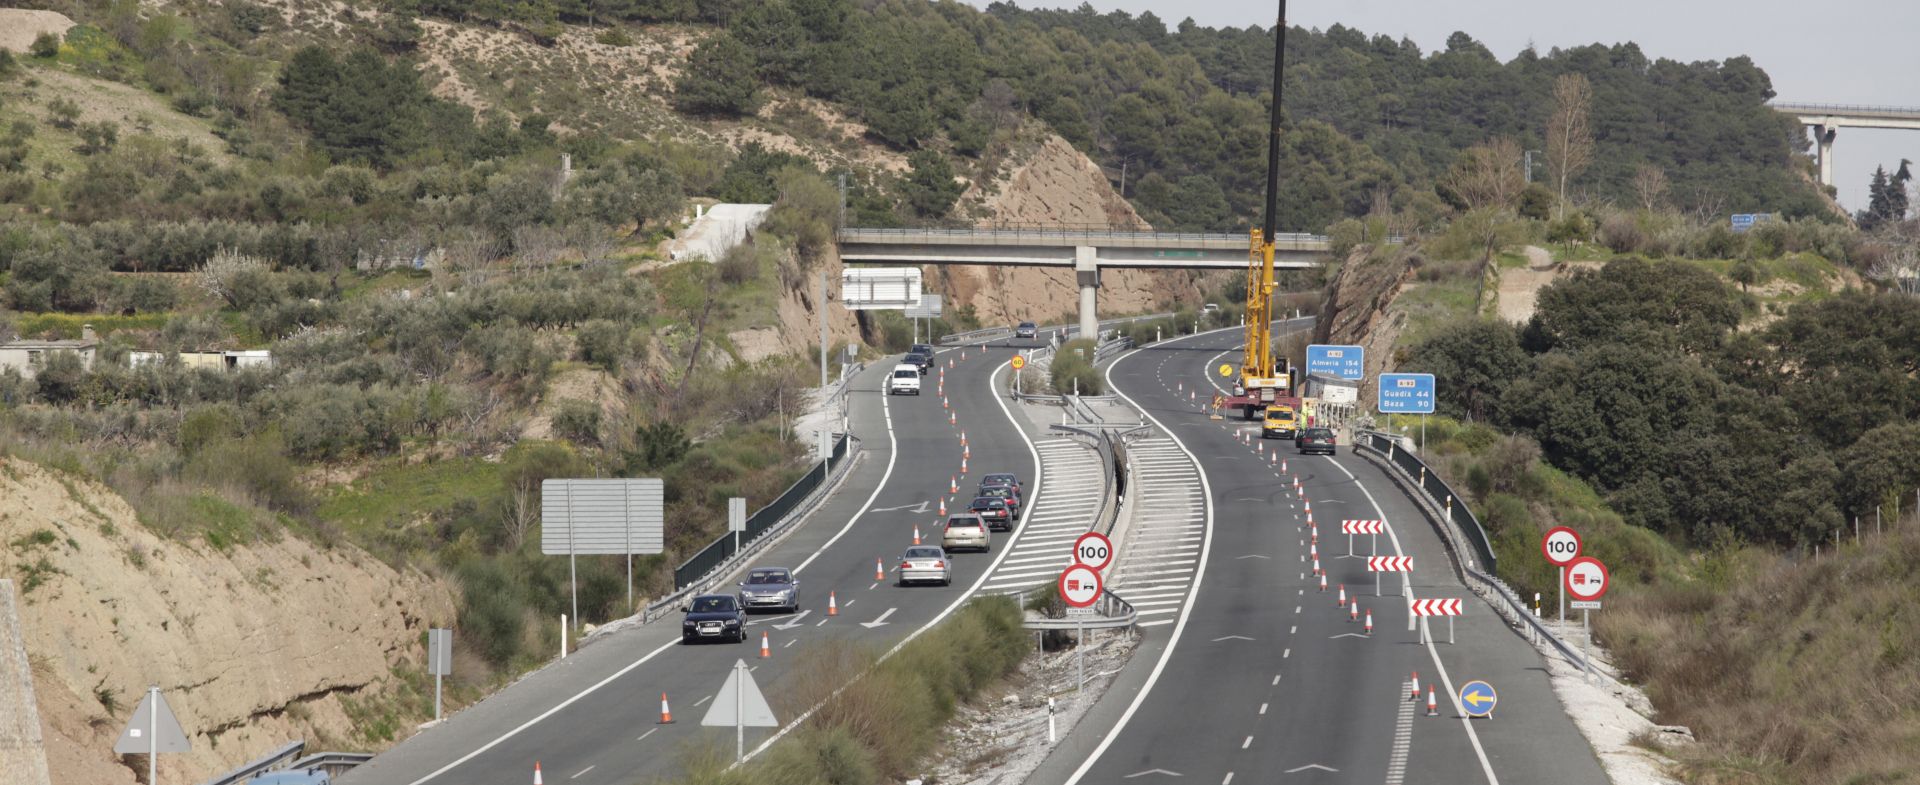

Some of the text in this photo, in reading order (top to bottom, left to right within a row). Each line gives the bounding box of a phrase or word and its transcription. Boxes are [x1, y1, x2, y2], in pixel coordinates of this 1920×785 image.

[1384, 390, 1429, 398] Guadix 44
[1079, 546, 1107, 559] 100
[1548, 541, 1576, 553] 100
